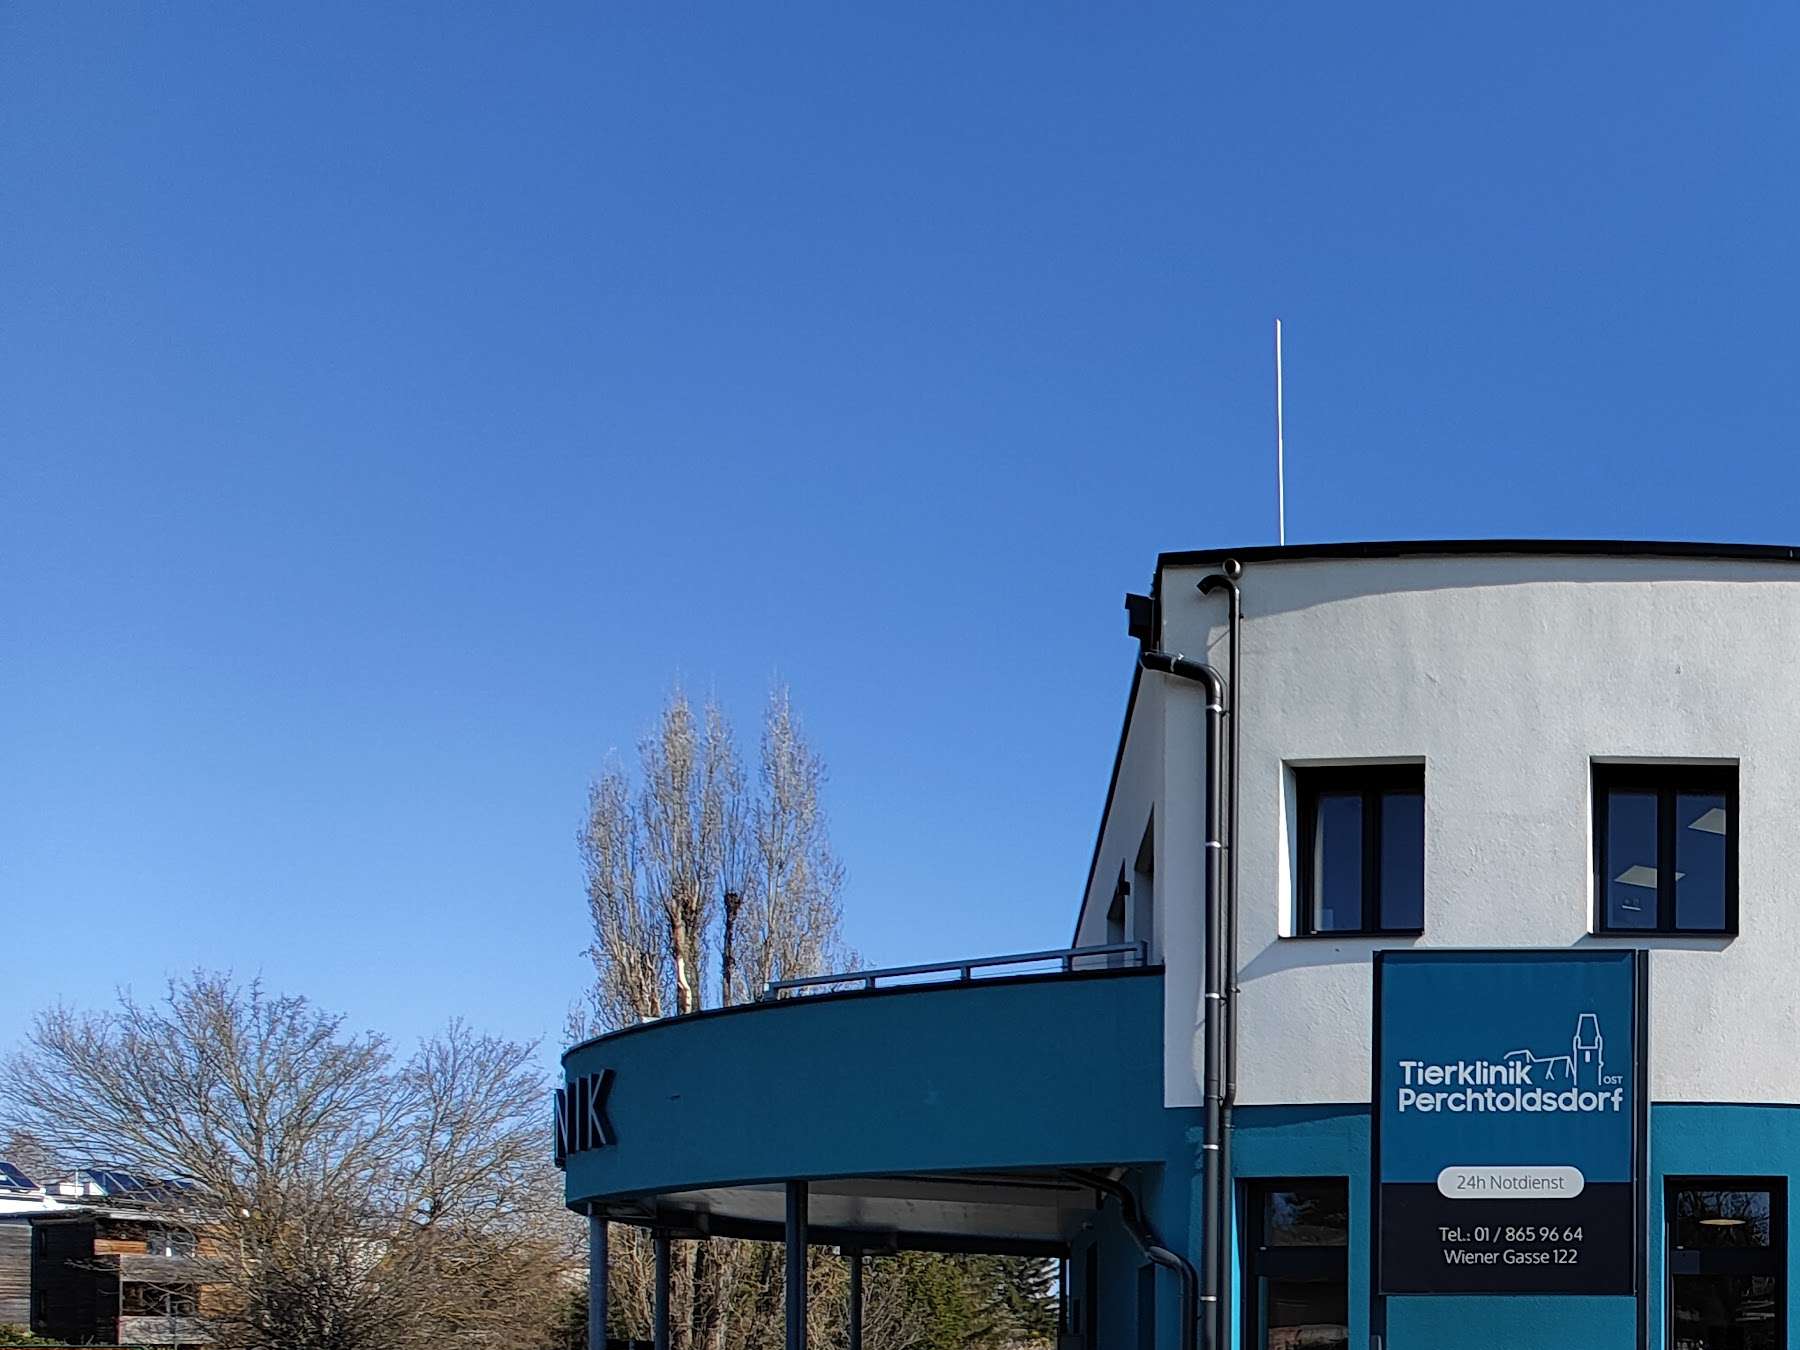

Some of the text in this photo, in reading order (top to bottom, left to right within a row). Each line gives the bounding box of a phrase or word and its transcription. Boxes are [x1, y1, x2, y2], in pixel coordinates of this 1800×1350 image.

[1399, 1060, 1533, 1086] Tierklinik
[1602, 1075, 1624, 1085] OST
[1398, 1087, 1624, 1112] Perchtoldsdorf
[1456, 1174, 1565, 1190] 24h Notdienst
[1438, 1226, 1471, 1242] Tel.:
[1474, 1226, 1490, 1242] 01
[1505, 1226, 1536, 1242] 865
[1539, 1226, 1560, 1242] 96
[1562, 1226, 1583, 1242] 64
[1443, 1249, 1578, 1264] Wiener Gasse 122
